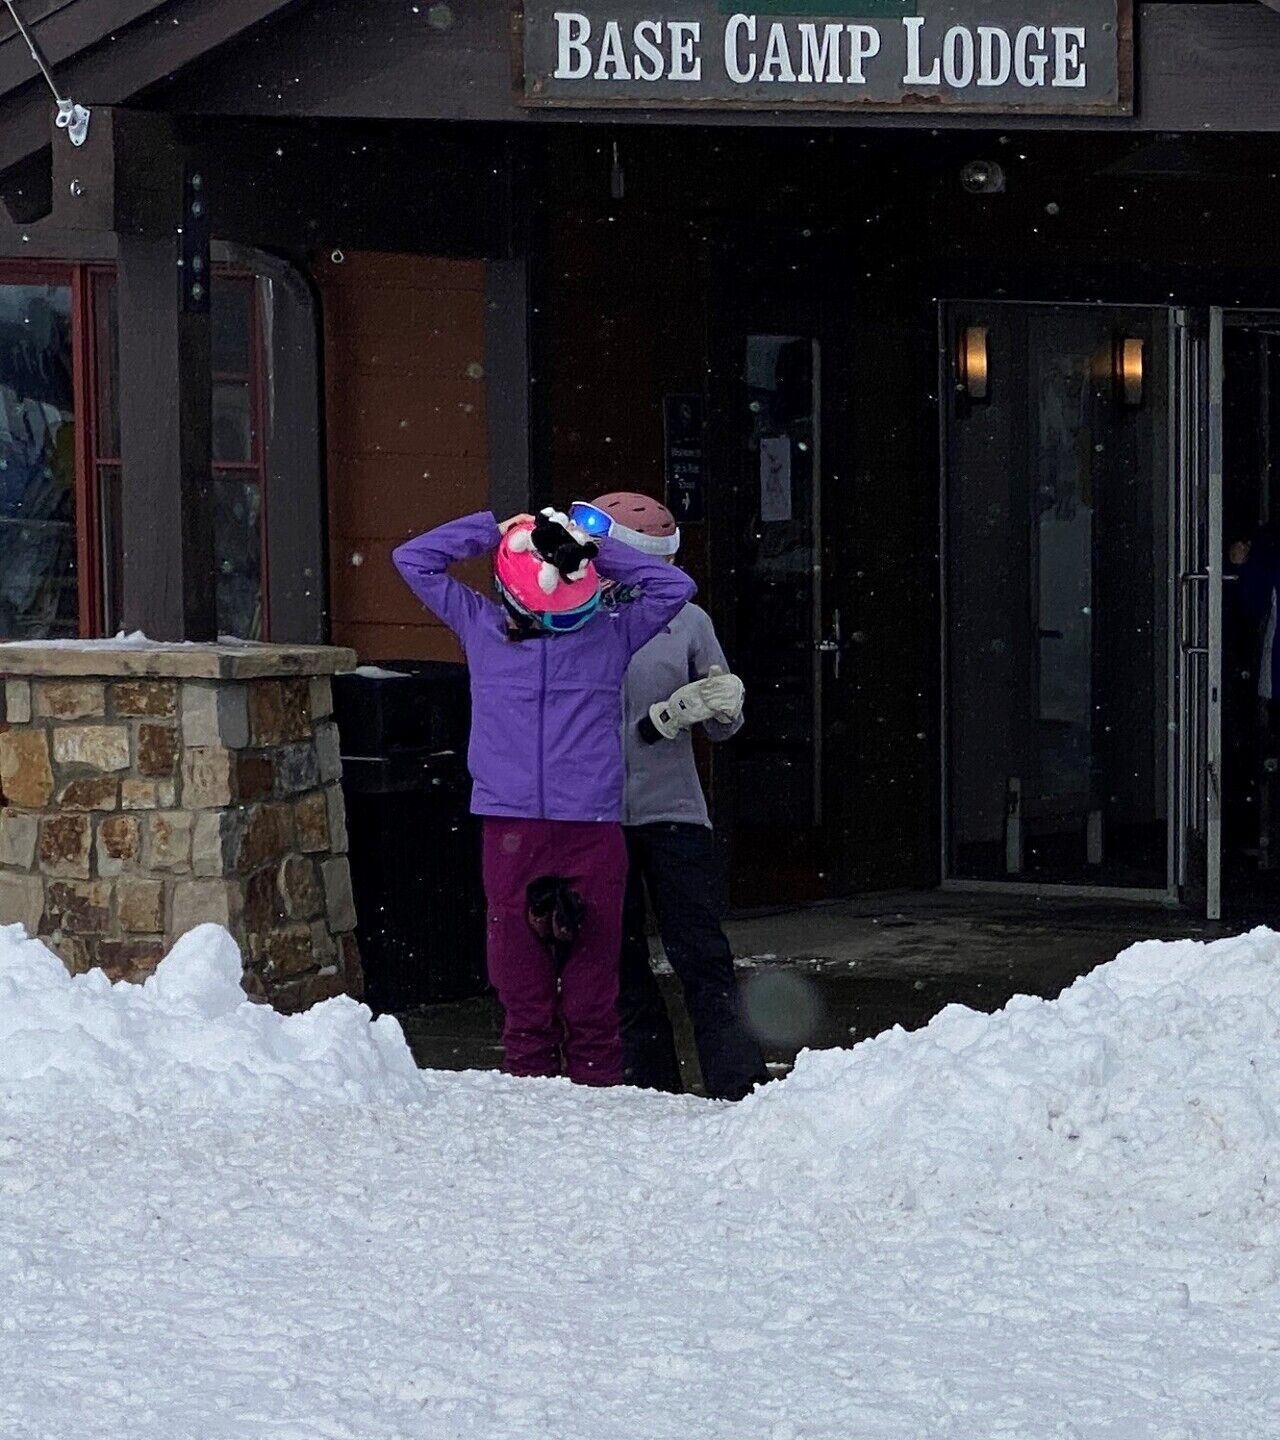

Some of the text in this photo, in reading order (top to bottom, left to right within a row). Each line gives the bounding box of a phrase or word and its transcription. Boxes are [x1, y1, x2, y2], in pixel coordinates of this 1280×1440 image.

[554, 12, 1087, 88] BASE CAMP LODGE
